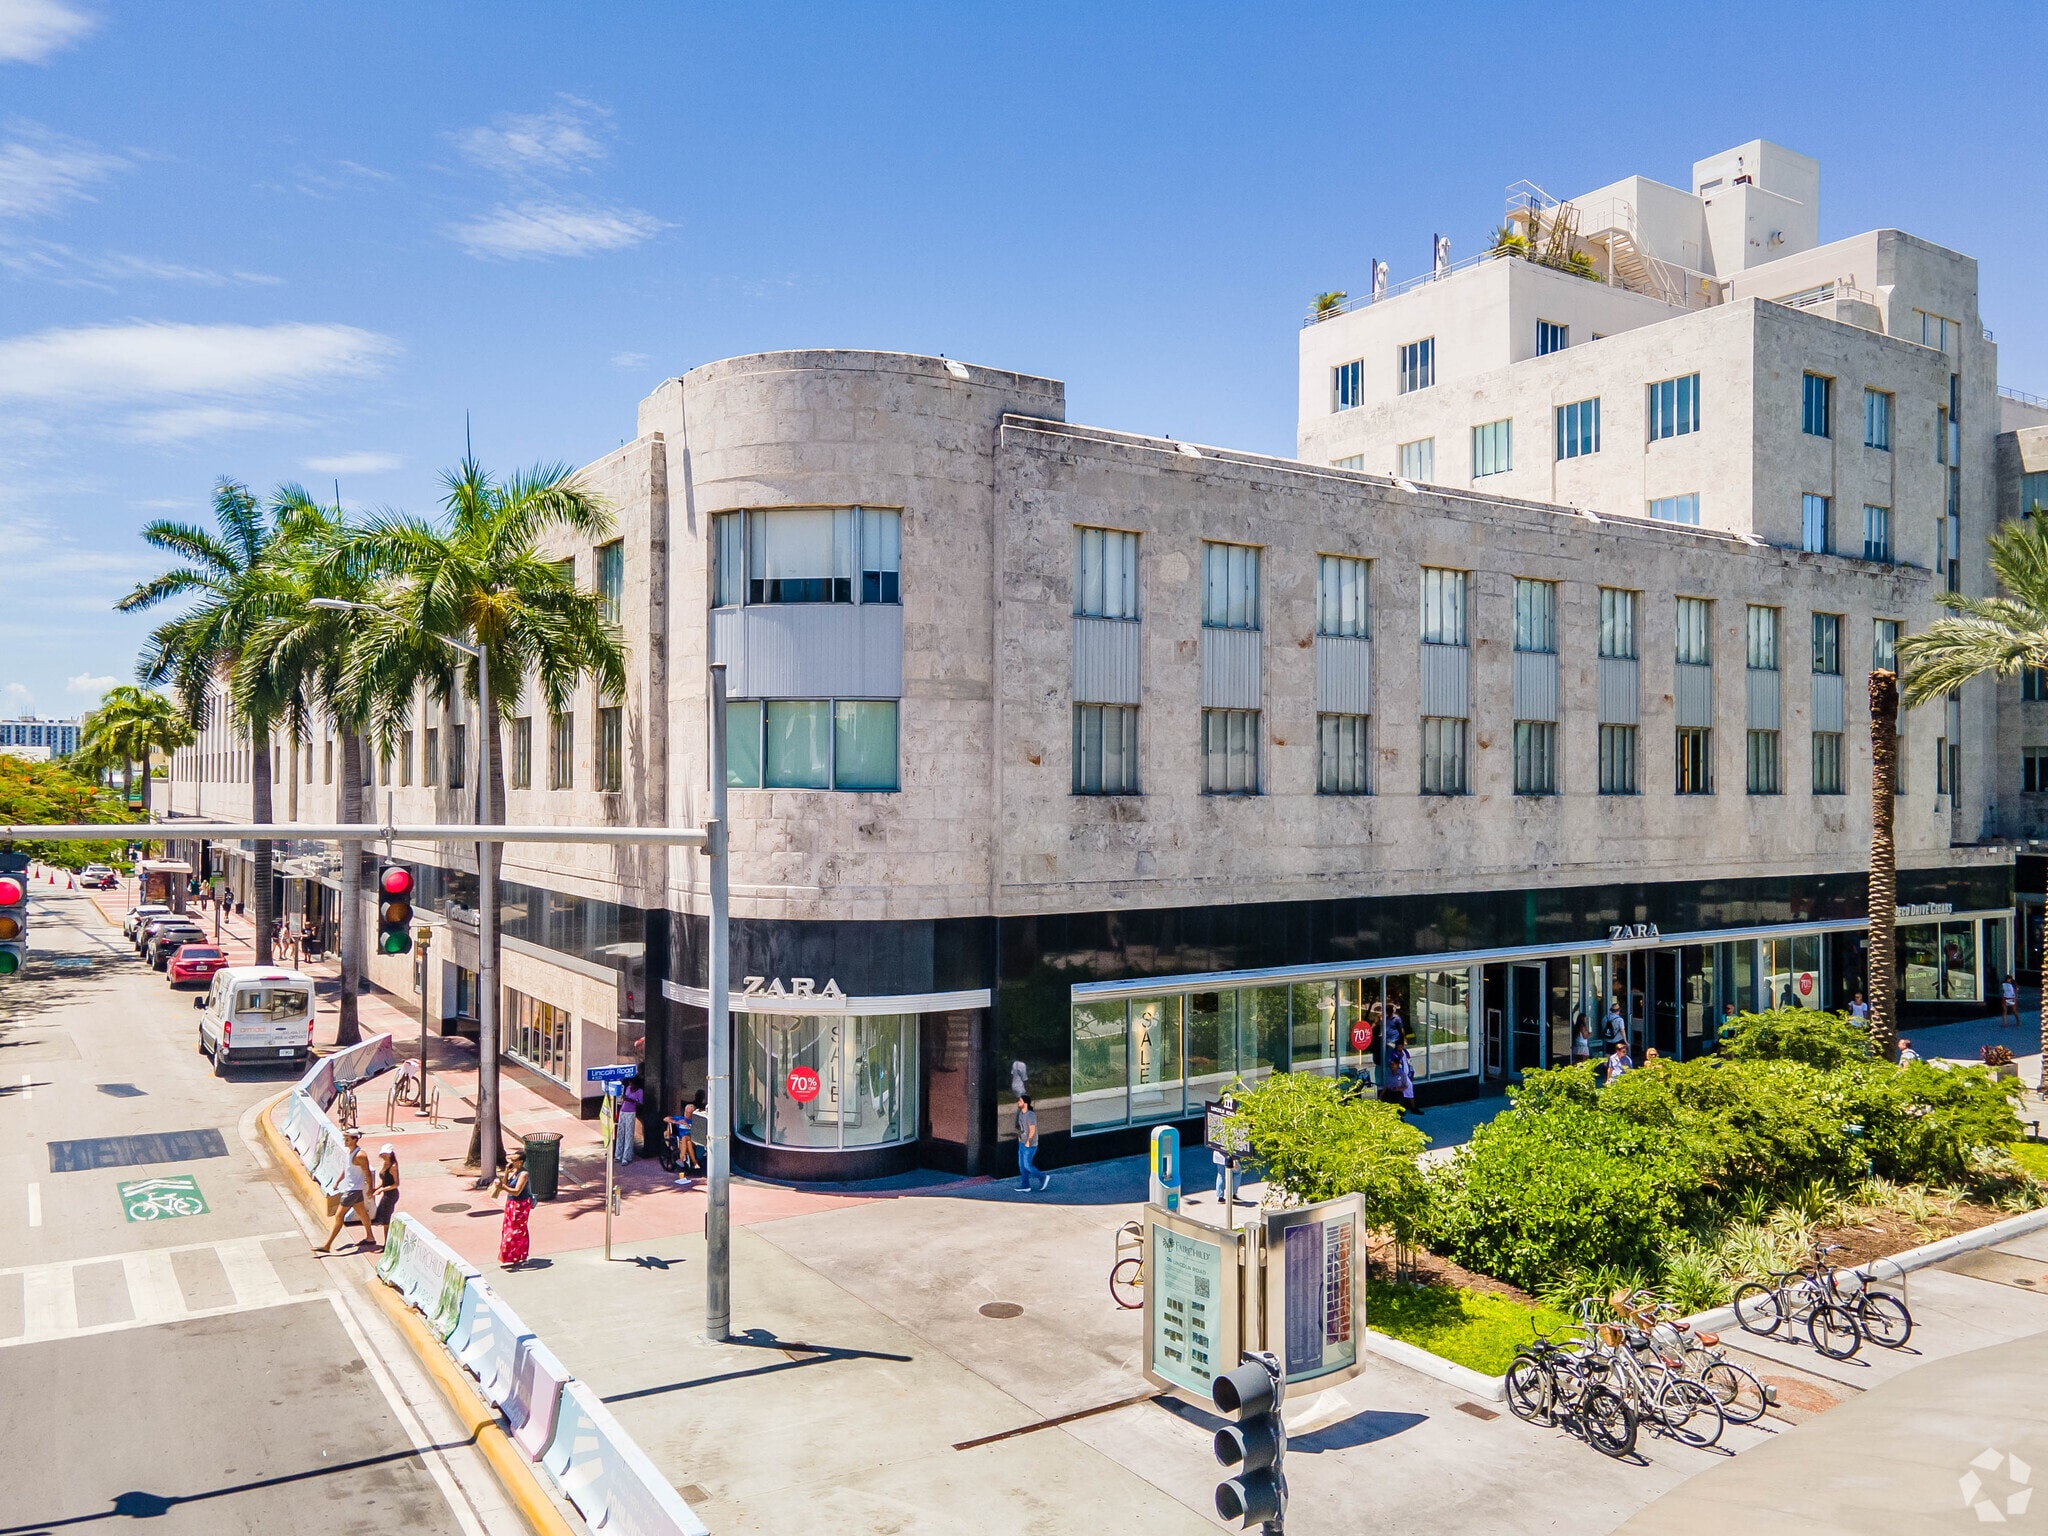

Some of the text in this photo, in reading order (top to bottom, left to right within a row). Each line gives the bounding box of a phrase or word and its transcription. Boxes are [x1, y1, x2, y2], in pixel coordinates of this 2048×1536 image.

[1929, 902, 1953, 914] CIGARS
[1610, 923, 1660, 940] ZARA
[743, 976, 845, 1000] ZARA
[1353, 1029, 1371, 1042] 70%
[1141, 1012, 1153, 1085] SALE
[591, 1069, 616, 1077] Lincoln
[616, 1066, 634, 1075] Road
[790, 1076, 817, 1091] 70%
[1175, 1241, 1210, 1261] FAIRCHILD
[1172, 1259, 1192, 1271] LINCOLN
[1192, 1266, 1207, 1276] ROAD
